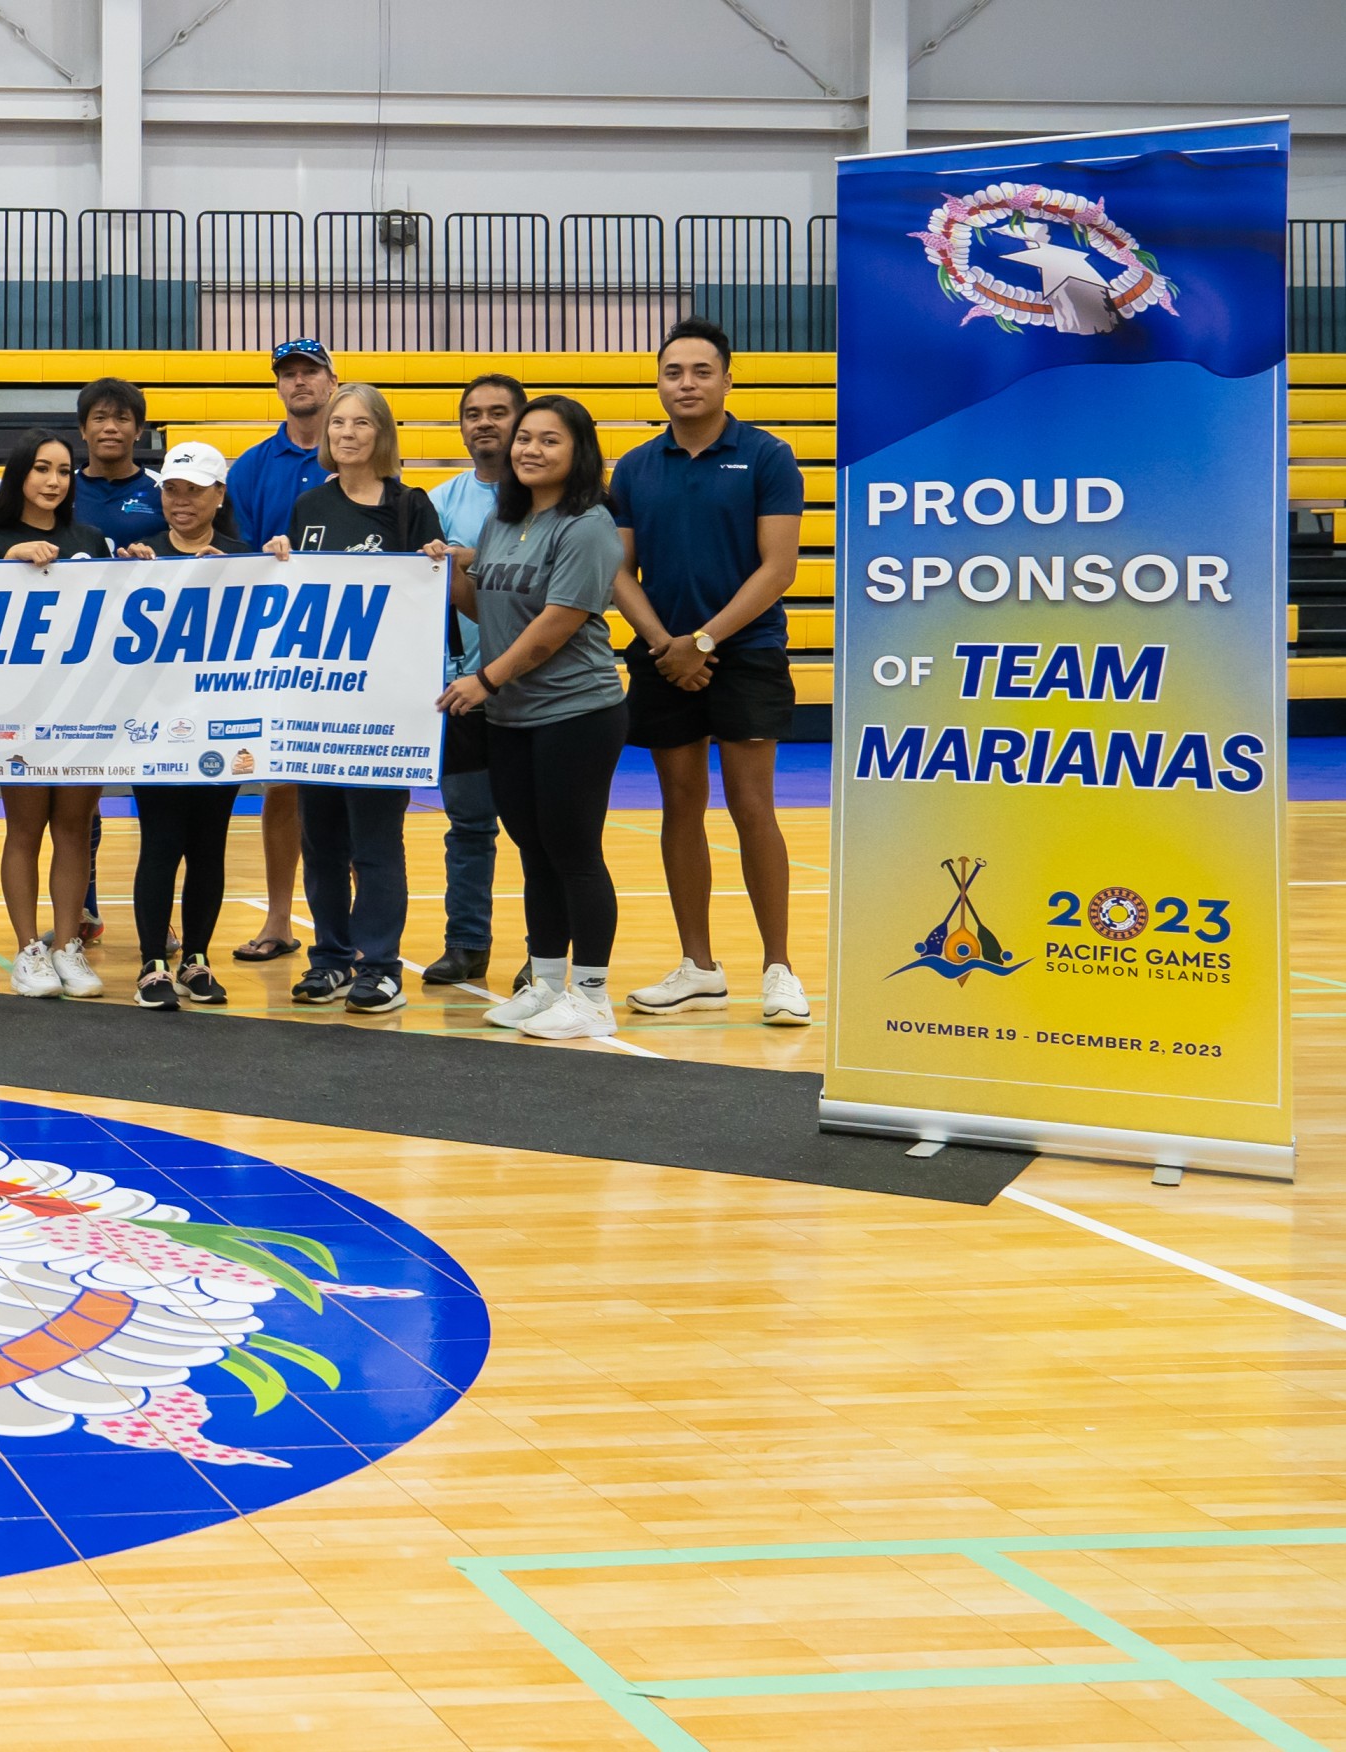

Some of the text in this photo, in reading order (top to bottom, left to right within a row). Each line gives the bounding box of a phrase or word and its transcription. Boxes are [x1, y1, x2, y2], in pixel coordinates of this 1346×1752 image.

[867, 478, 1125, 526] PROUD
[866, 555, 1232, 602] SPONSOR
[61, 590, 106, 665] J
[113, 583, 391, 665] SAIPAN
[195, 665, 368, 693] www.triplej.net
[872, 642, 1169, 702] OF TEAM
[52, 724, 78, 732] Payless
[225, 722, 261, 735] CATERING
[287, 720, 395, 736] TINIAN VILLAGE LODGE
[287, 741, 430, 758] TINIAN CONFERENCE CENTER
[854, 725, 1266, 793] MARIANAS
[26, 766, 135, 776] TINIAN WESTERN LODGE
[157, 763, 189, 772] TRIPLE J
[311, 763, 336, 775] LUBE
[337, 767, 345, 775] &
[348, 765, 369, 777] CAR
[372, 766, 404, 778] WASH
[405, 768, 432, 779] SHOP
[1046, 943, 1231, 970] PACIFIC GAMES
[1046, 962, 1231, 984] SOLOMON ISLANDS
[886, 1019, 989, 1040] NOVEMBER
[995, 1028, 1017, 1041] 19
[1036, 1031, 1142, 1052] DECEMBER
[1149, 1040, 1166, 1055] 2,
[1172, 1041, 1223, 1058] 2023
